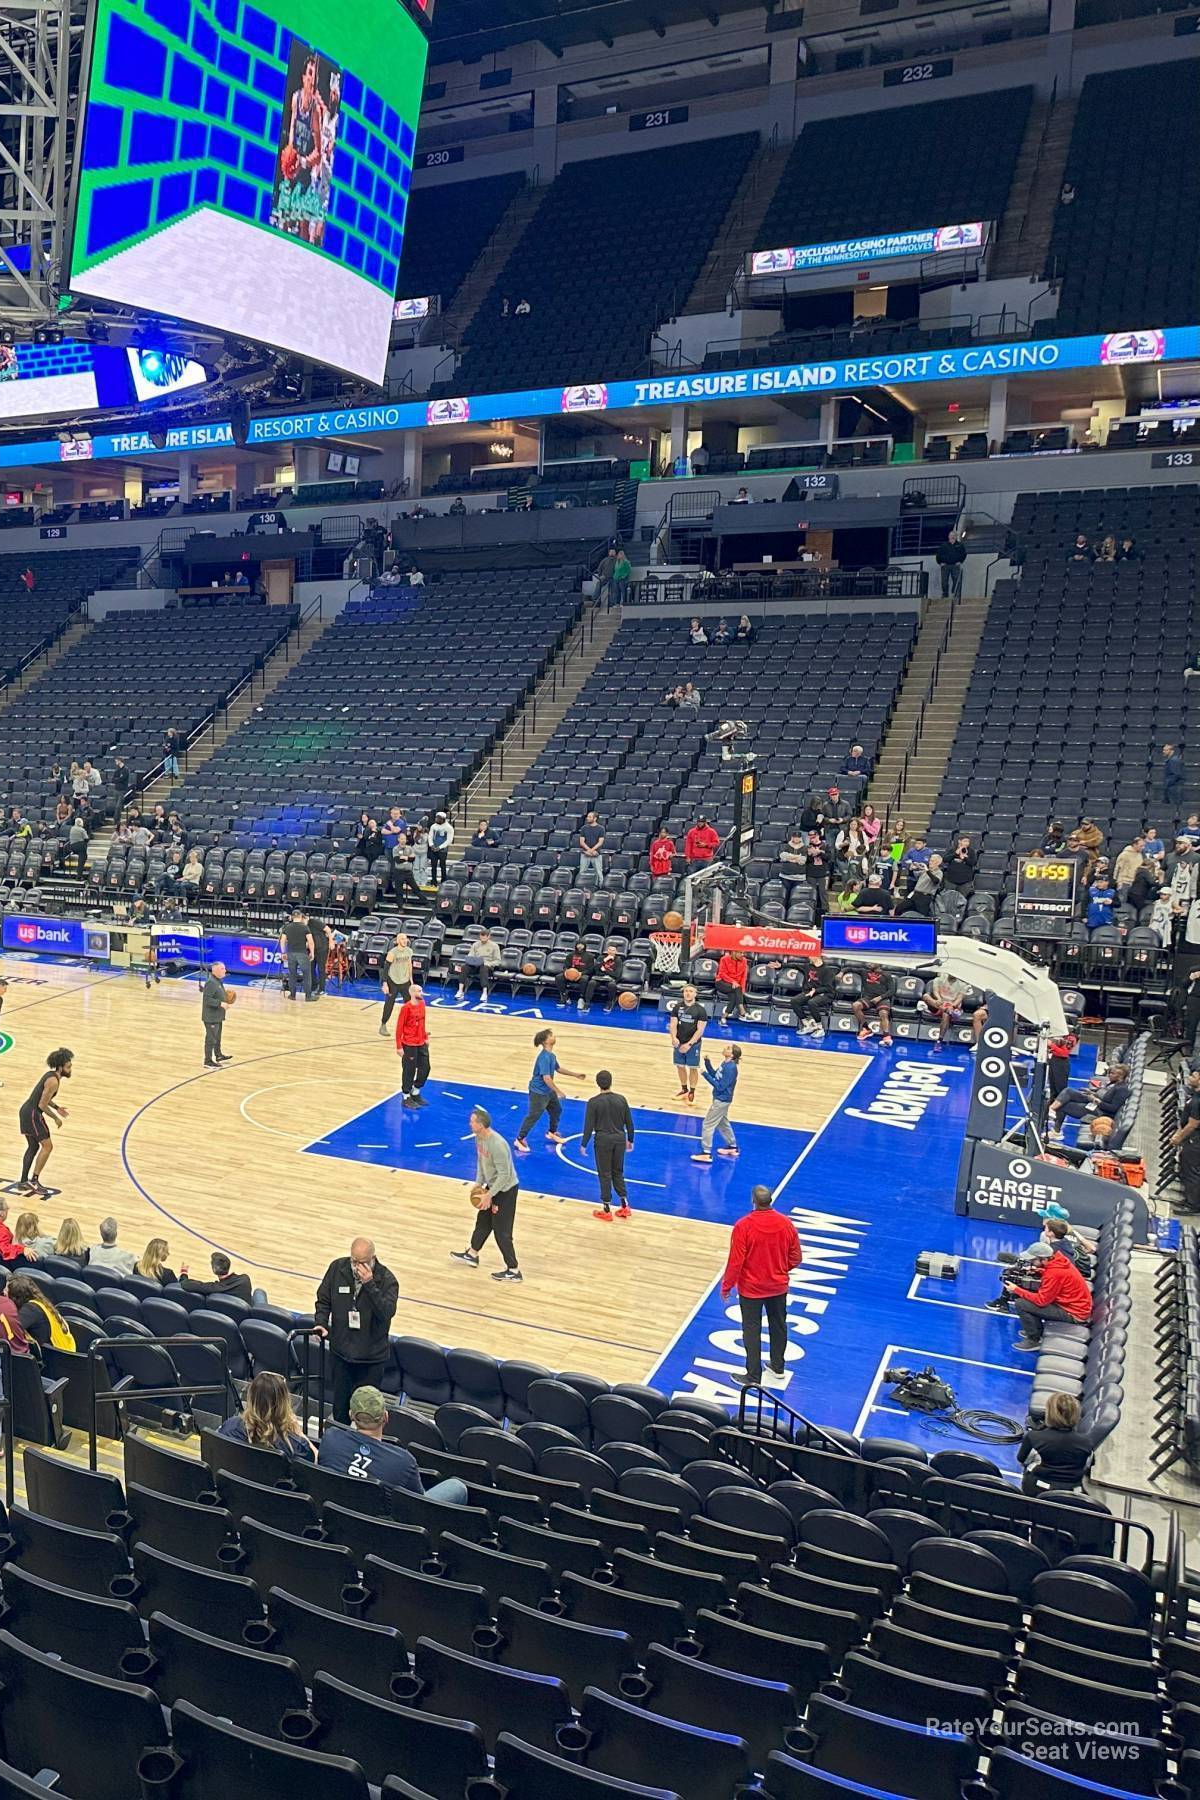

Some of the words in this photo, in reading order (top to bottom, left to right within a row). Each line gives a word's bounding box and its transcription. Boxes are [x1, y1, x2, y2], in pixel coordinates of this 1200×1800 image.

[903, 64, 933, 82] 232
[645, 111, 670, 126] 231
[427, 151, 449, 165] 230
[795, 244, 846, 259] EXCLUSIVE
[847, 238, 886, 251] CASINO
[887, 232, 933, 246] PARTNER
[795, 258, 806, 267] OF
[807, 256, 822, 265] THE
[823, 250, 870, 263] MINNESOTA
[871, 241, 933, 258] TIMBERWOLVES
[635, 374, 747, 400] TREASURE
[752, 366, 837, 391] ISLAND
[844, 356, 933, 382] RESORT
[939, 355, 956, 374] &
[963, 345, 1059, 371] CASINO
[112, 428, 188, 452] TREARE
[254, 418, 314, 438] RESORT
[318, 418, 330, 432] &
[334, 409, 399, 430] CASINO
[1166, 454, 1192, 466] 133
[803, 475, 826, 488] 132
[259, 513, 276, 524] 130
[46, 528, 60, 538] 129
[1034, 902, 1071, 912] TISSOT
[18, 926, 35, 939] us
[37, 926, 71, 942] bank
[848, 929, 866, 940] us
[869, 928, 909, 942] bank
[242, 948, 260, 962] us
[263, 948, 283, 966] ba
[844, 1060, 965, 1130] betway
[976, 1175, 1062, 1200] TARGET
[351, 1453, 373, 1469] 27
